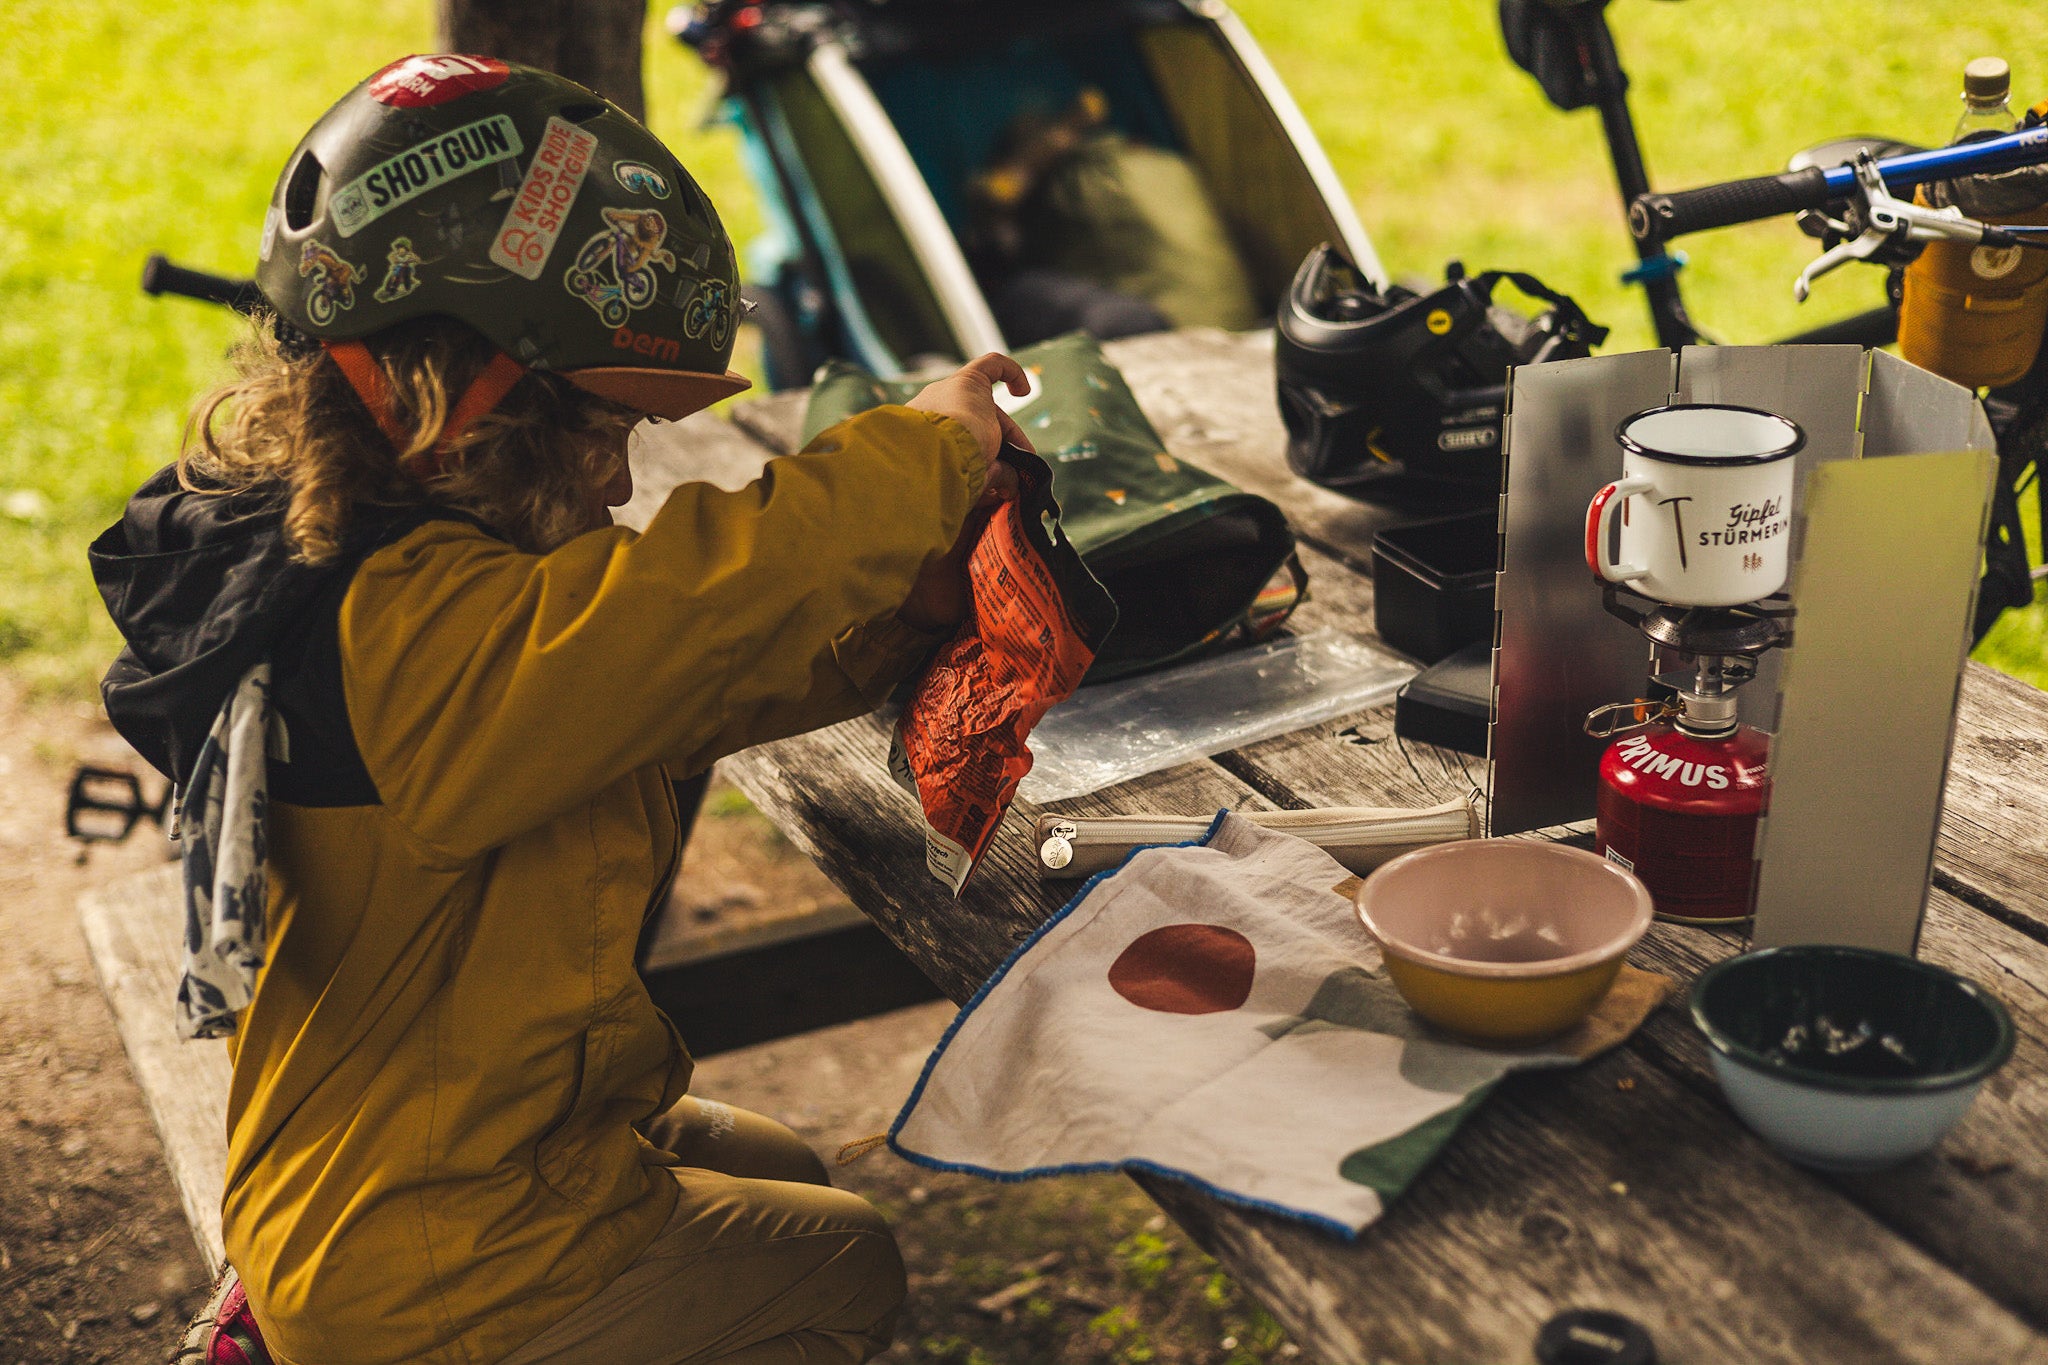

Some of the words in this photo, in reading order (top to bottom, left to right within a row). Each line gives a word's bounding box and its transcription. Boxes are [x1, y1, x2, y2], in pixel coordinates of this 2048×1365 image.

[366, 119, 511, 207] SHOTGUN
[514, 165, 554, 223] KIDS
[540, 123, 572, 169] RIDE
[537, 133, 593, 233] SHOTGUN
[612, 327, 681, 363] bern
[1726, 494, 1782, 529] Gipfel
[1615, 734, 1730, 790] PRIMUS
